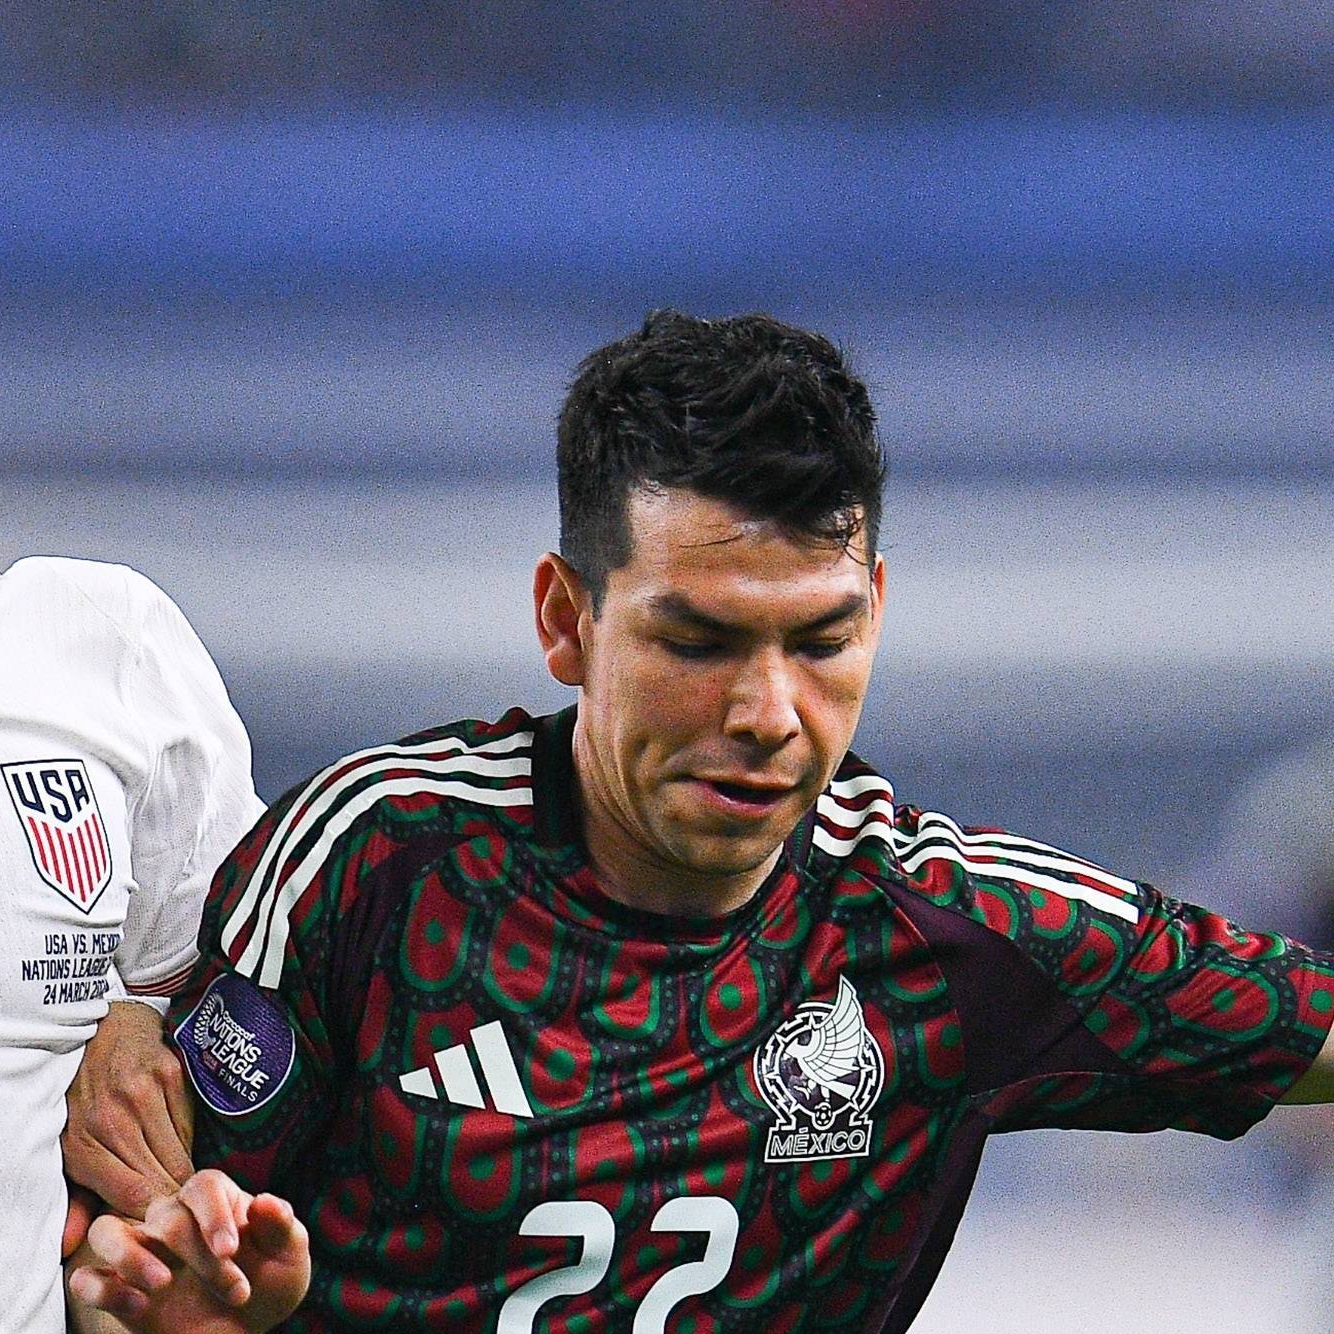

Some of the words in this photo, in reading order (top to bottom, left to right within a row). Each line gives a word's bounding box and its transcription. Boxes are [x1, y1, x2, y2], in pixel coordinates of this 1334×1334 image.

[11, 769, 90, 823] USA
[45, 934, 68, 955] USA
[72, 933, 88, 954] VS.
[22, 958, 71, 981] NATIONS
[43, 984, 57, 1005] 24
[59, 981, 91, 1004] MARCH
[210, 1013, 262, 1063] NATIONS
[222, 1010, 256, 1041] Concacaf
[211, 1039, 270, 1090] LEAGUE
[219, 1068, 258, 1102] FINALS
[770, 1127, 866, 1156] MÉXICO
